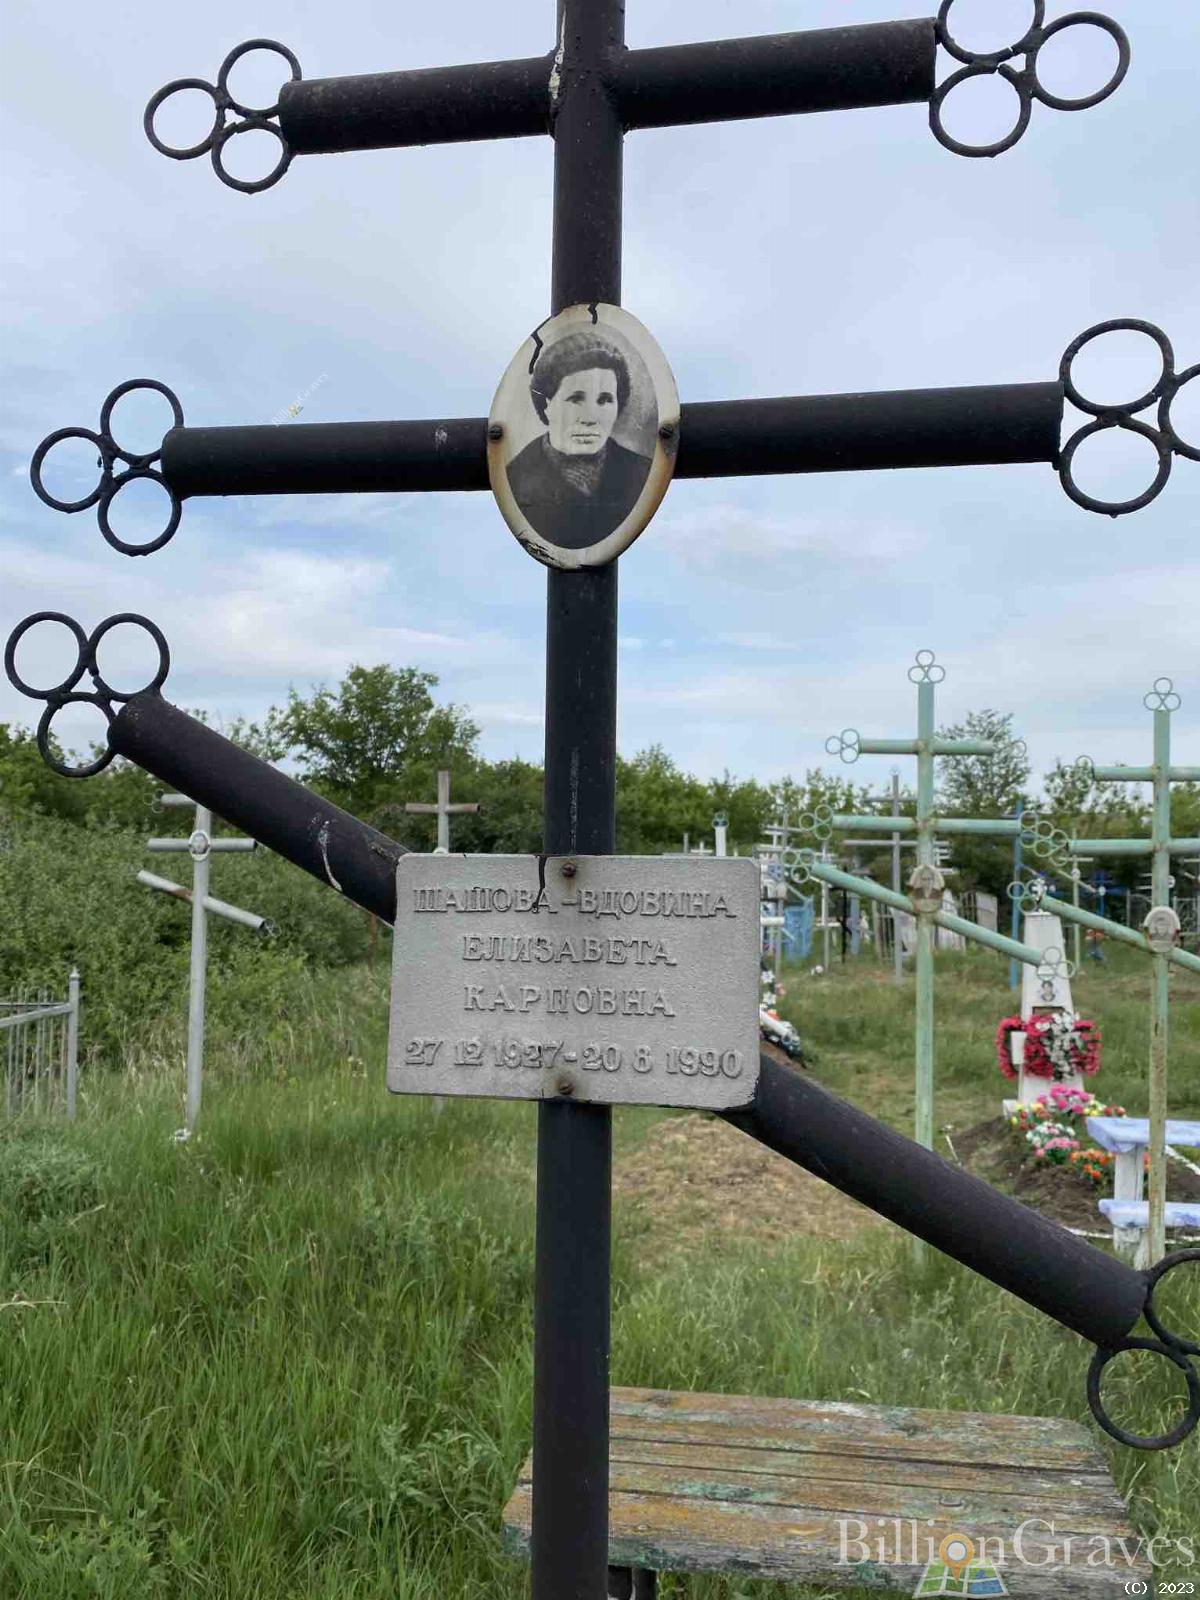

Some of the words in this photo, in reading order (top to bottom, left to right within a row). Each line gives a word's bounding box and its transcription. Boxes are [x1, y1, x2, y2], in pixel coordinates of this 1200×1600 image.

[462, 933, 678, 966] ЕЛИЗАВЕТА
[463, 984, 676, 1017] КАРПОВНА
[404, 1038, 444, 1066] 27
[453, 1038, 483, 1066] 12
[664, 1046, 745, 1079] 1990
